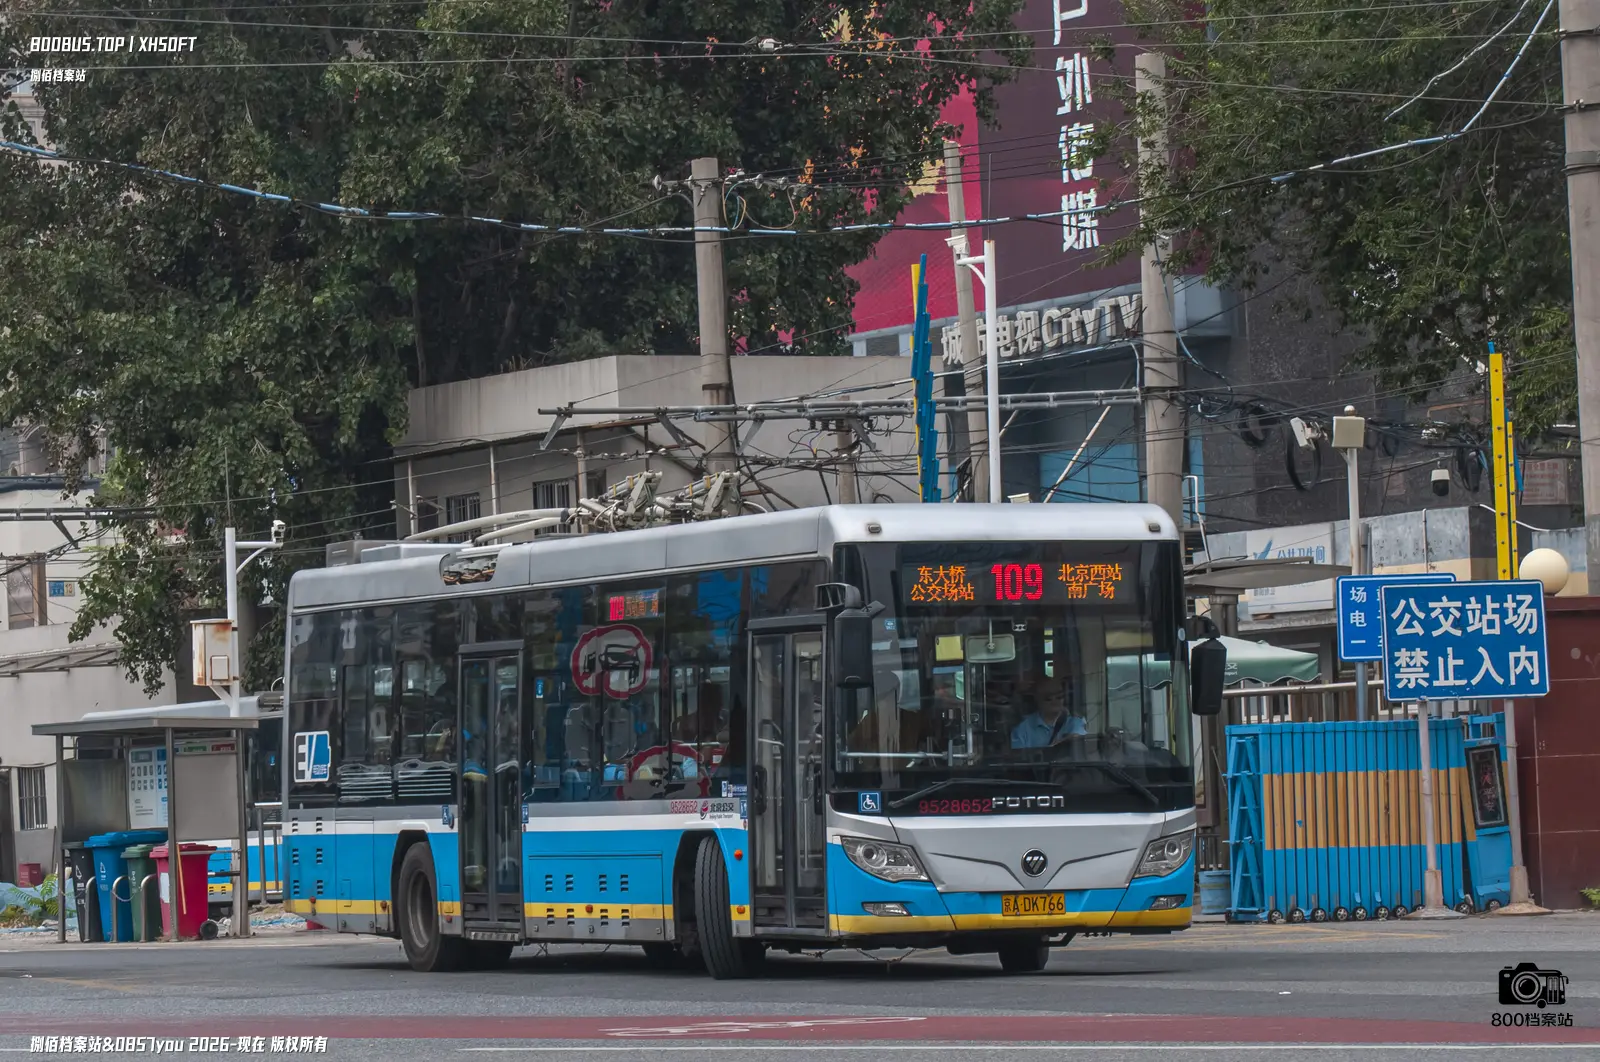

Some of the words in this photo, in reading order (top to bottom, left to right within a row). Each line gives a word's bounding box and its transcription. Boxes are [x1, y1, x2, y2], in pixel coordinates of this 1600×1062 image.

[917, 566, 966, 584] 东大桥
[1058, 564, 1122, 581] 北京西站
[991, 564, 1042, 600] 109
[1066, 581, 1115, 599] 南广场
[911, 584, 974, 601] 公交场站
[1391, 594, 1538, 637] 公交站场
[1394, 645, 1540, 688] 禁止入内
[671, 801, 698, 813] 9528652
[710, 803, 734, 812] 北京公交
[919, 800, 992, 814] 9528652
[992, 796, 1065, 808] FOTON
